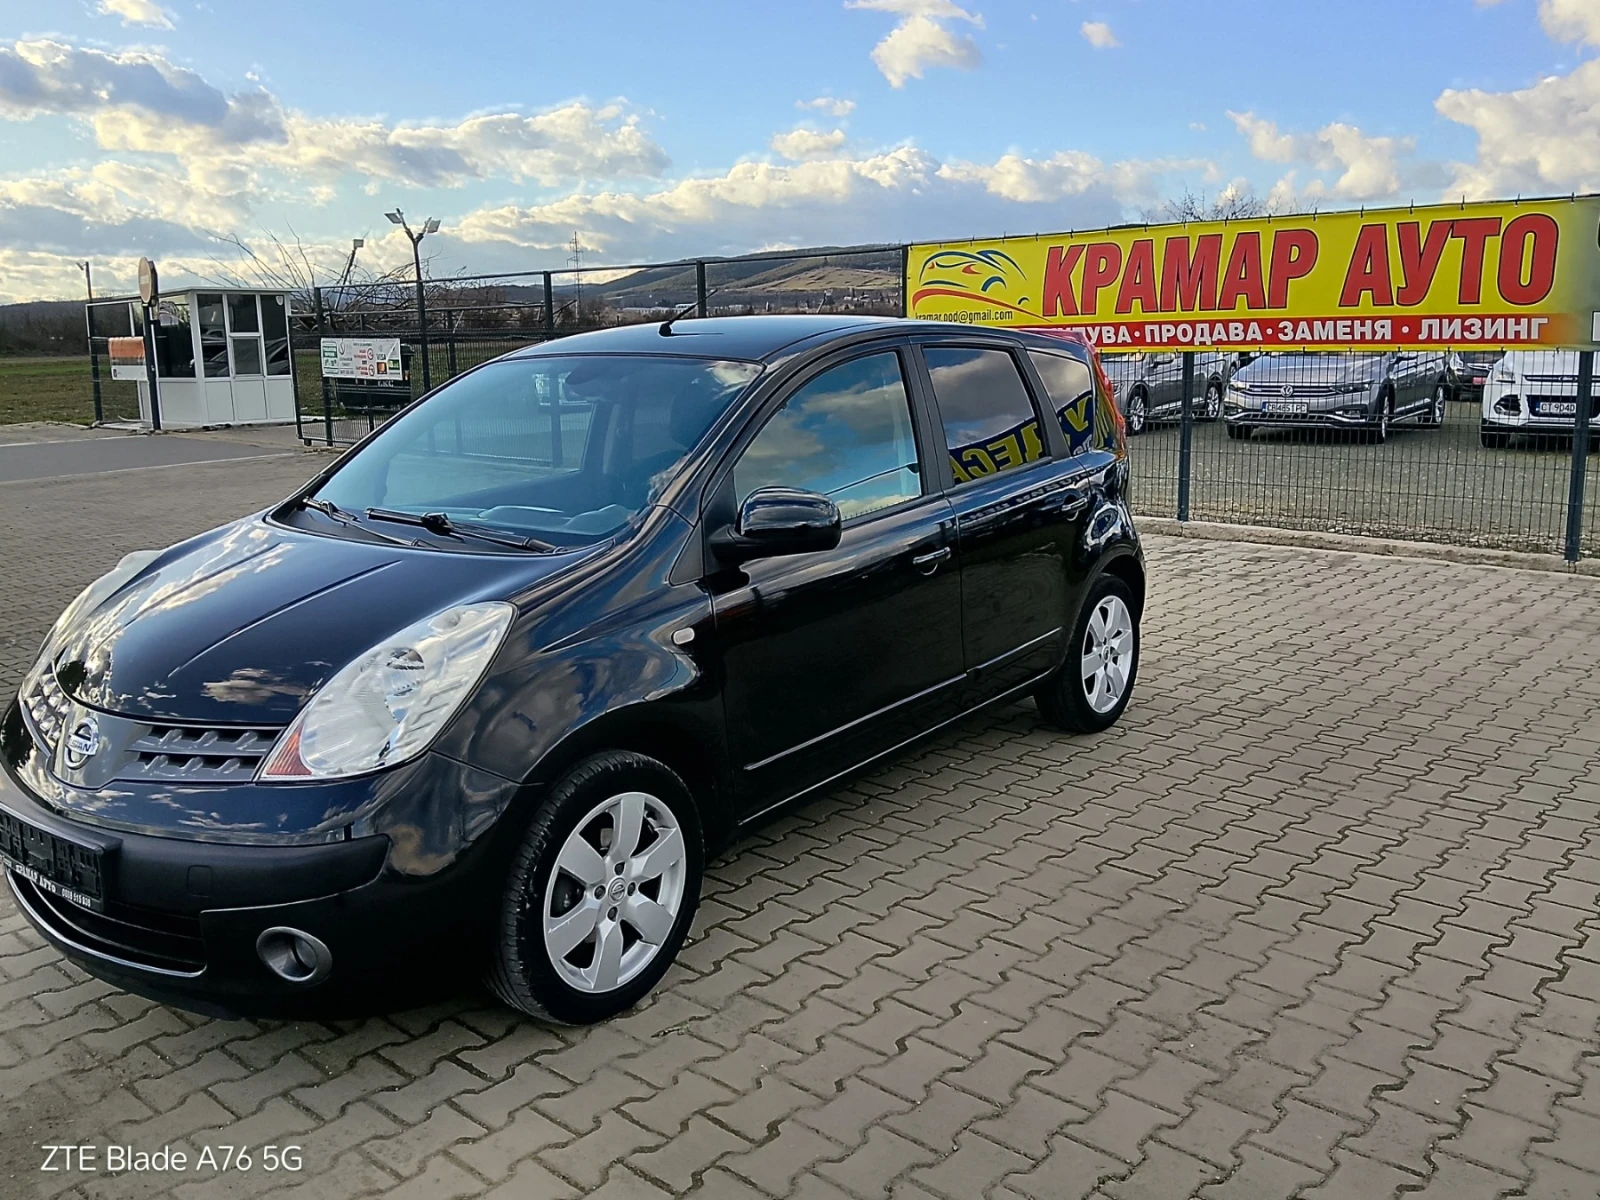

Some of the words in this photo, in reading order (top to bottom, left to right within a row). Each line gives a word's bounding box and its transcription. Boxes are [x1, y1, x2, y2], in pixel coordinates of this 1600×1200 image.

[1042, 228, 1319, 317] КРАМАР
[1339, 212, 1560, 307] АУТО
[1144, 320, 1263, 346] ПРОДАВА
[1277, 319, 1393, 342] ЗАМЕНЯ
[1417, 317, 1549, 341] ЛИЗИНГ
